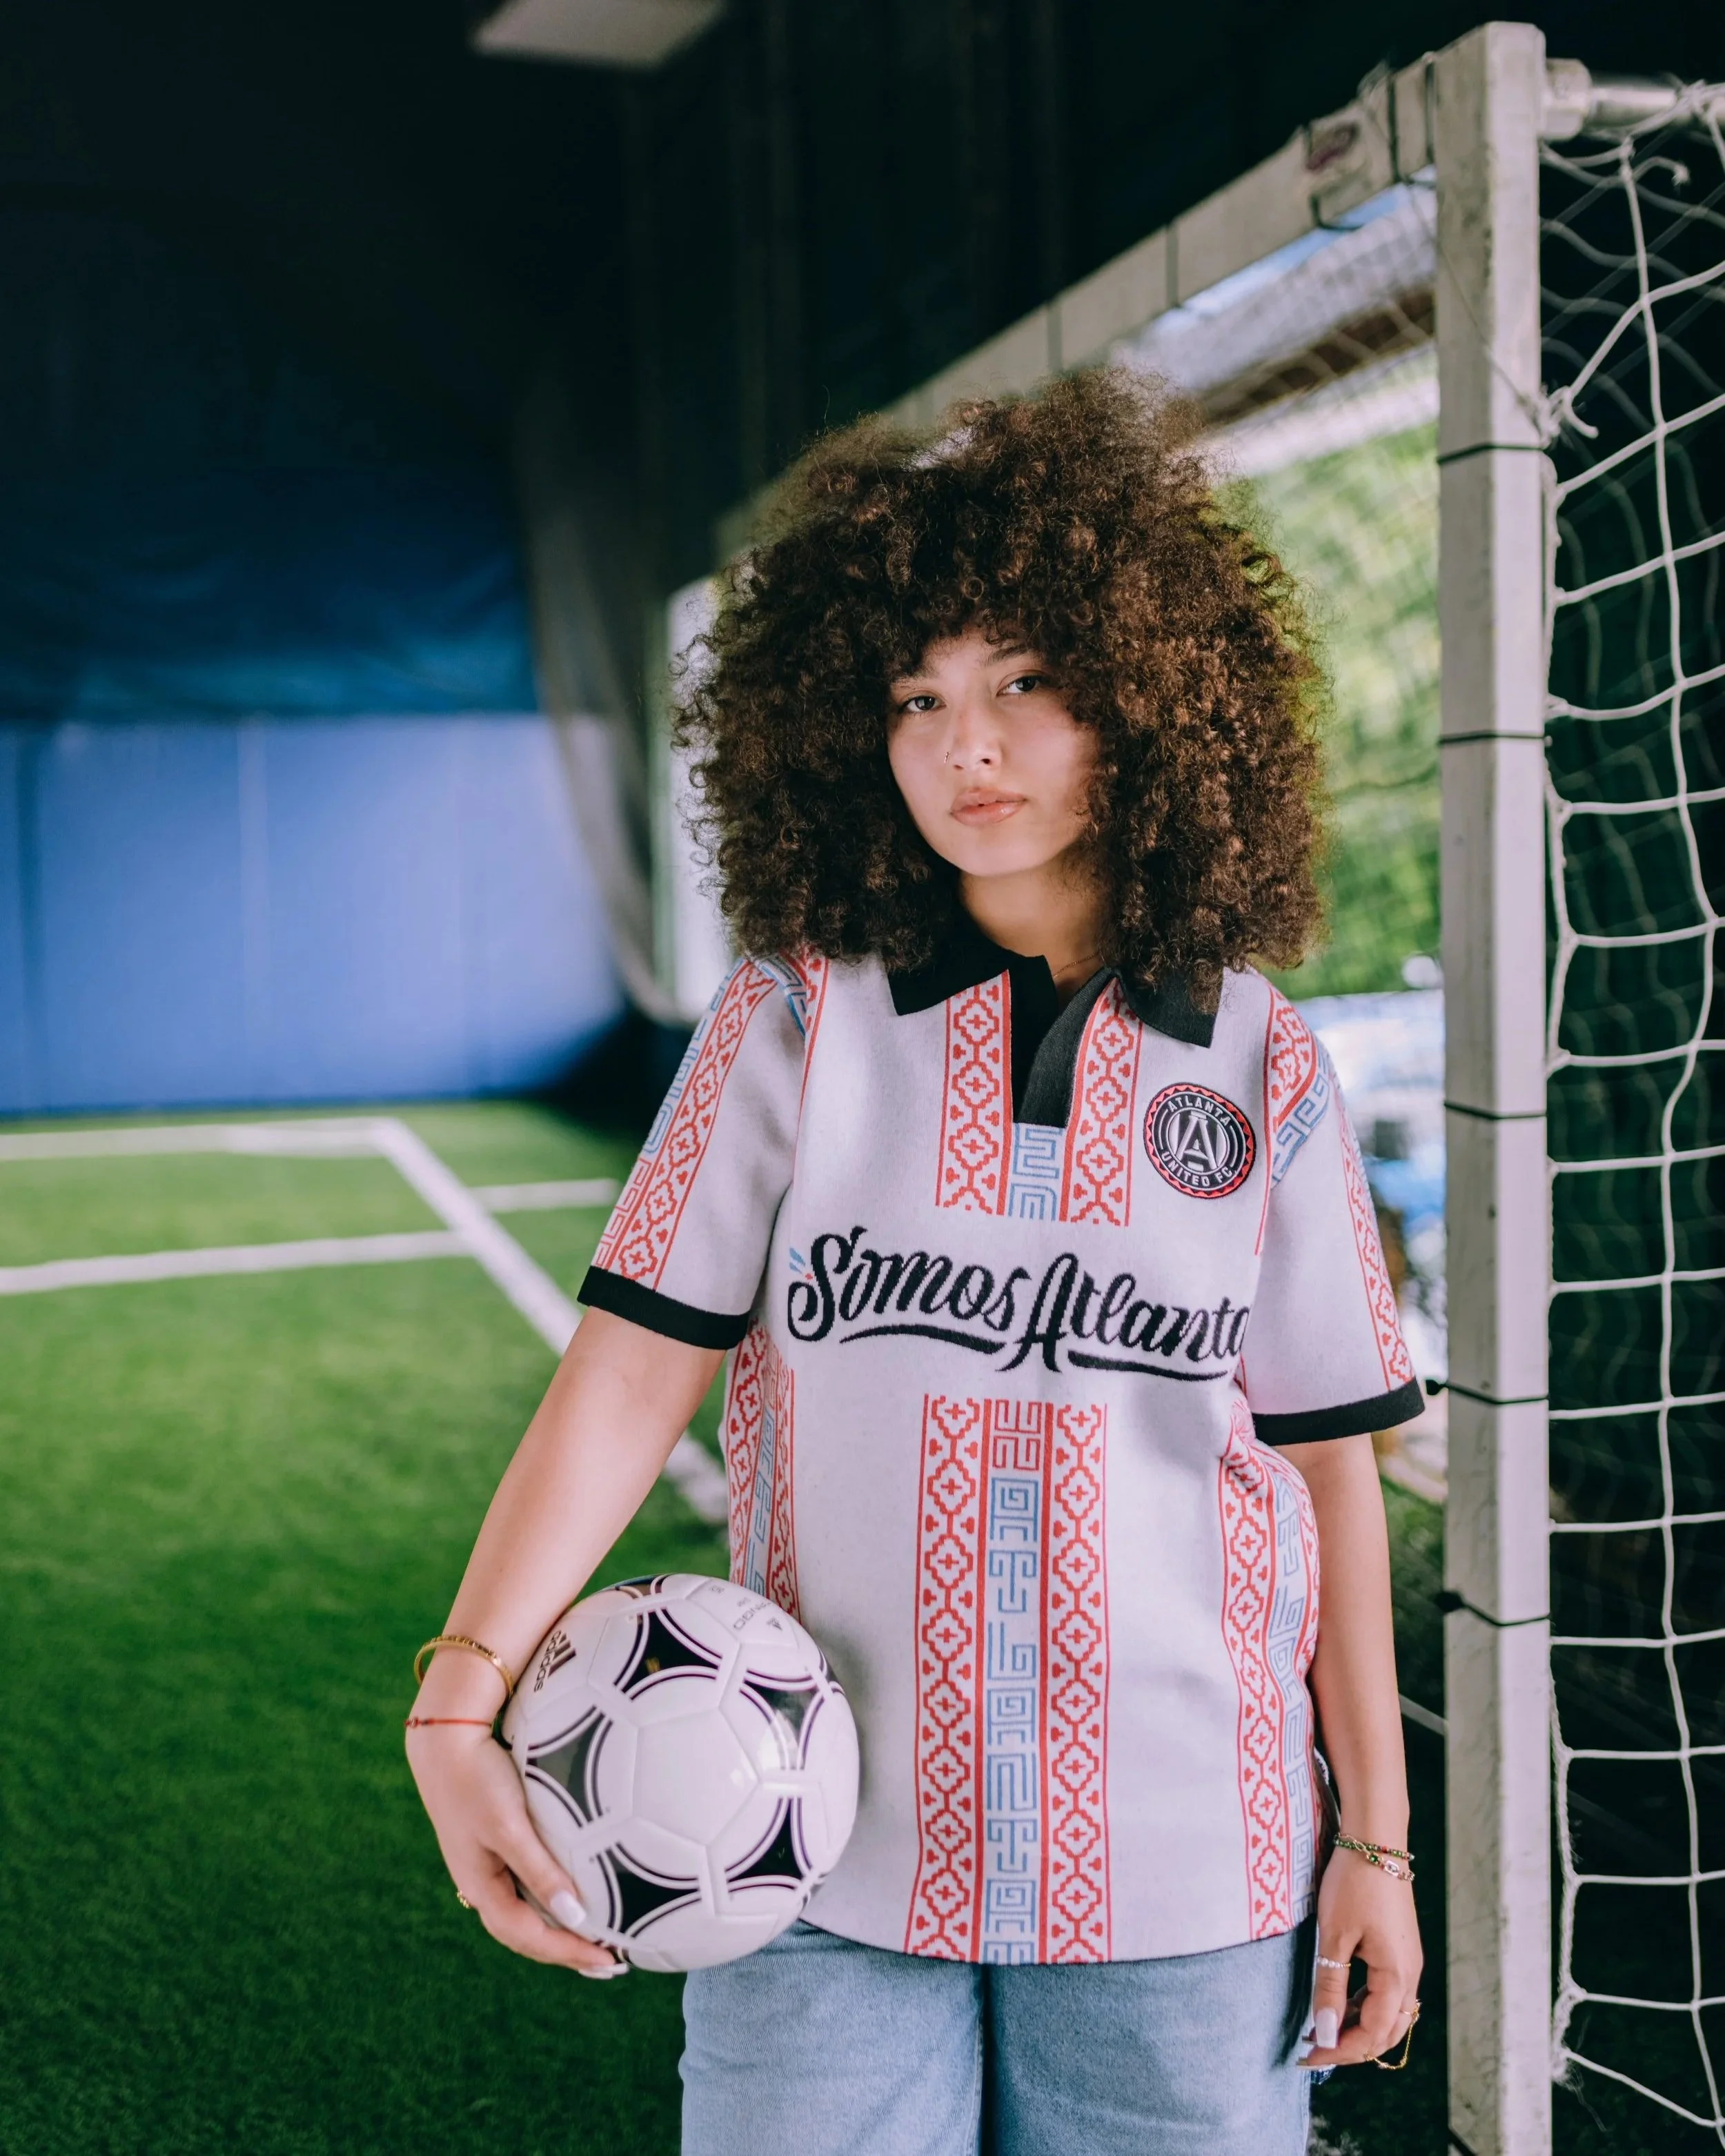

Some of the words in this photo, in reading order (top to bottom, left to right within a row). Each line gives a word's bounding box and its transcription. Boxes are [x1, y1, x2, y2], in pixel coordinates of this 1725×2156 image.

[1167, 1095, 1232, 1127] ATLANTA
[1162, 1151, 1210, 1186] UNITED
[1214, 1166, 1233, 1184] FC
[787, 1225, 1032, 1343] Somos
[533, 1630, 563, 1692] adidas
